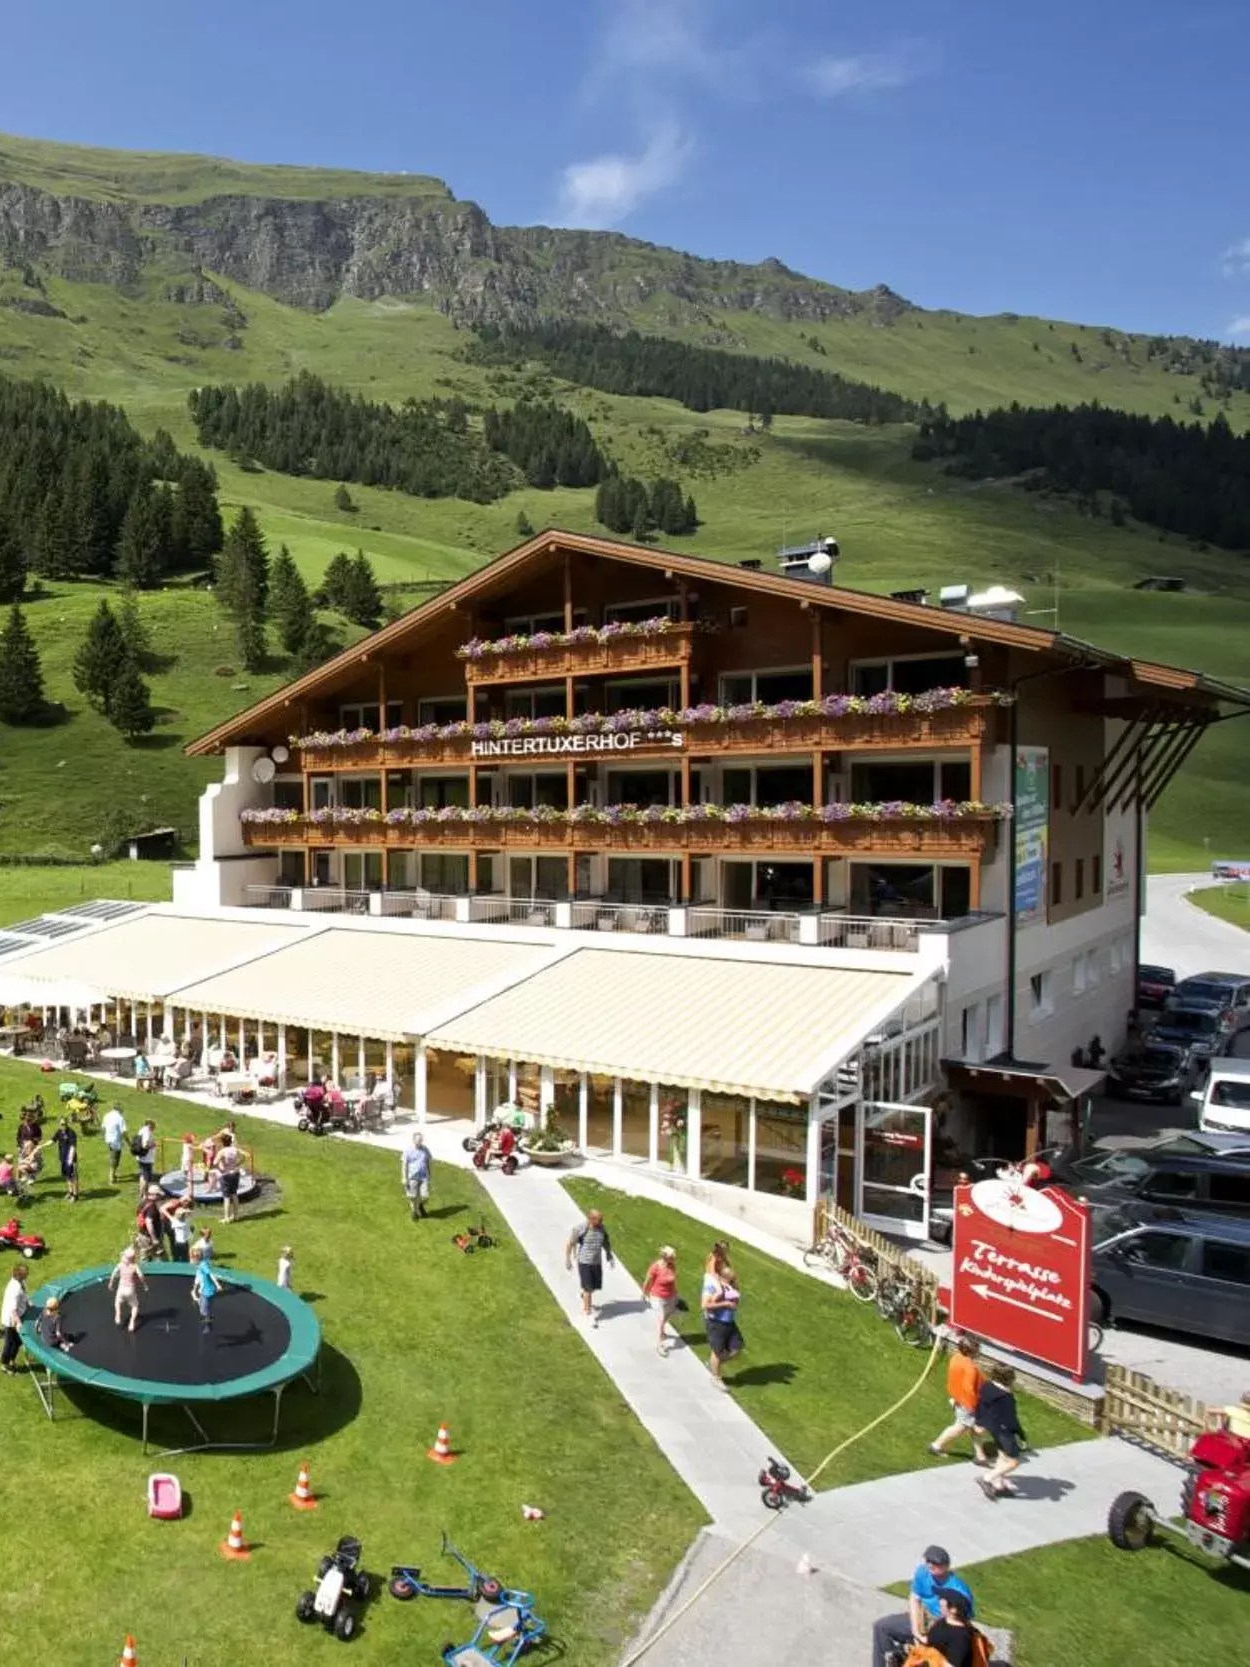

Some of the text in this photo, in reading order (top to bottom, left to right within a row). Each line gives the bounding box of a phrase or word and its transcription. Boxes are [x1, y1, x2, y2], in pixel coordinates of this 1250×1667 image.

[471, 732, 641, 756] HINTERTUXERHOF
[959, 1256, 1072, 1309] Kinderspielplatz
[970, 1239, 1062, 1284] Terrasse
